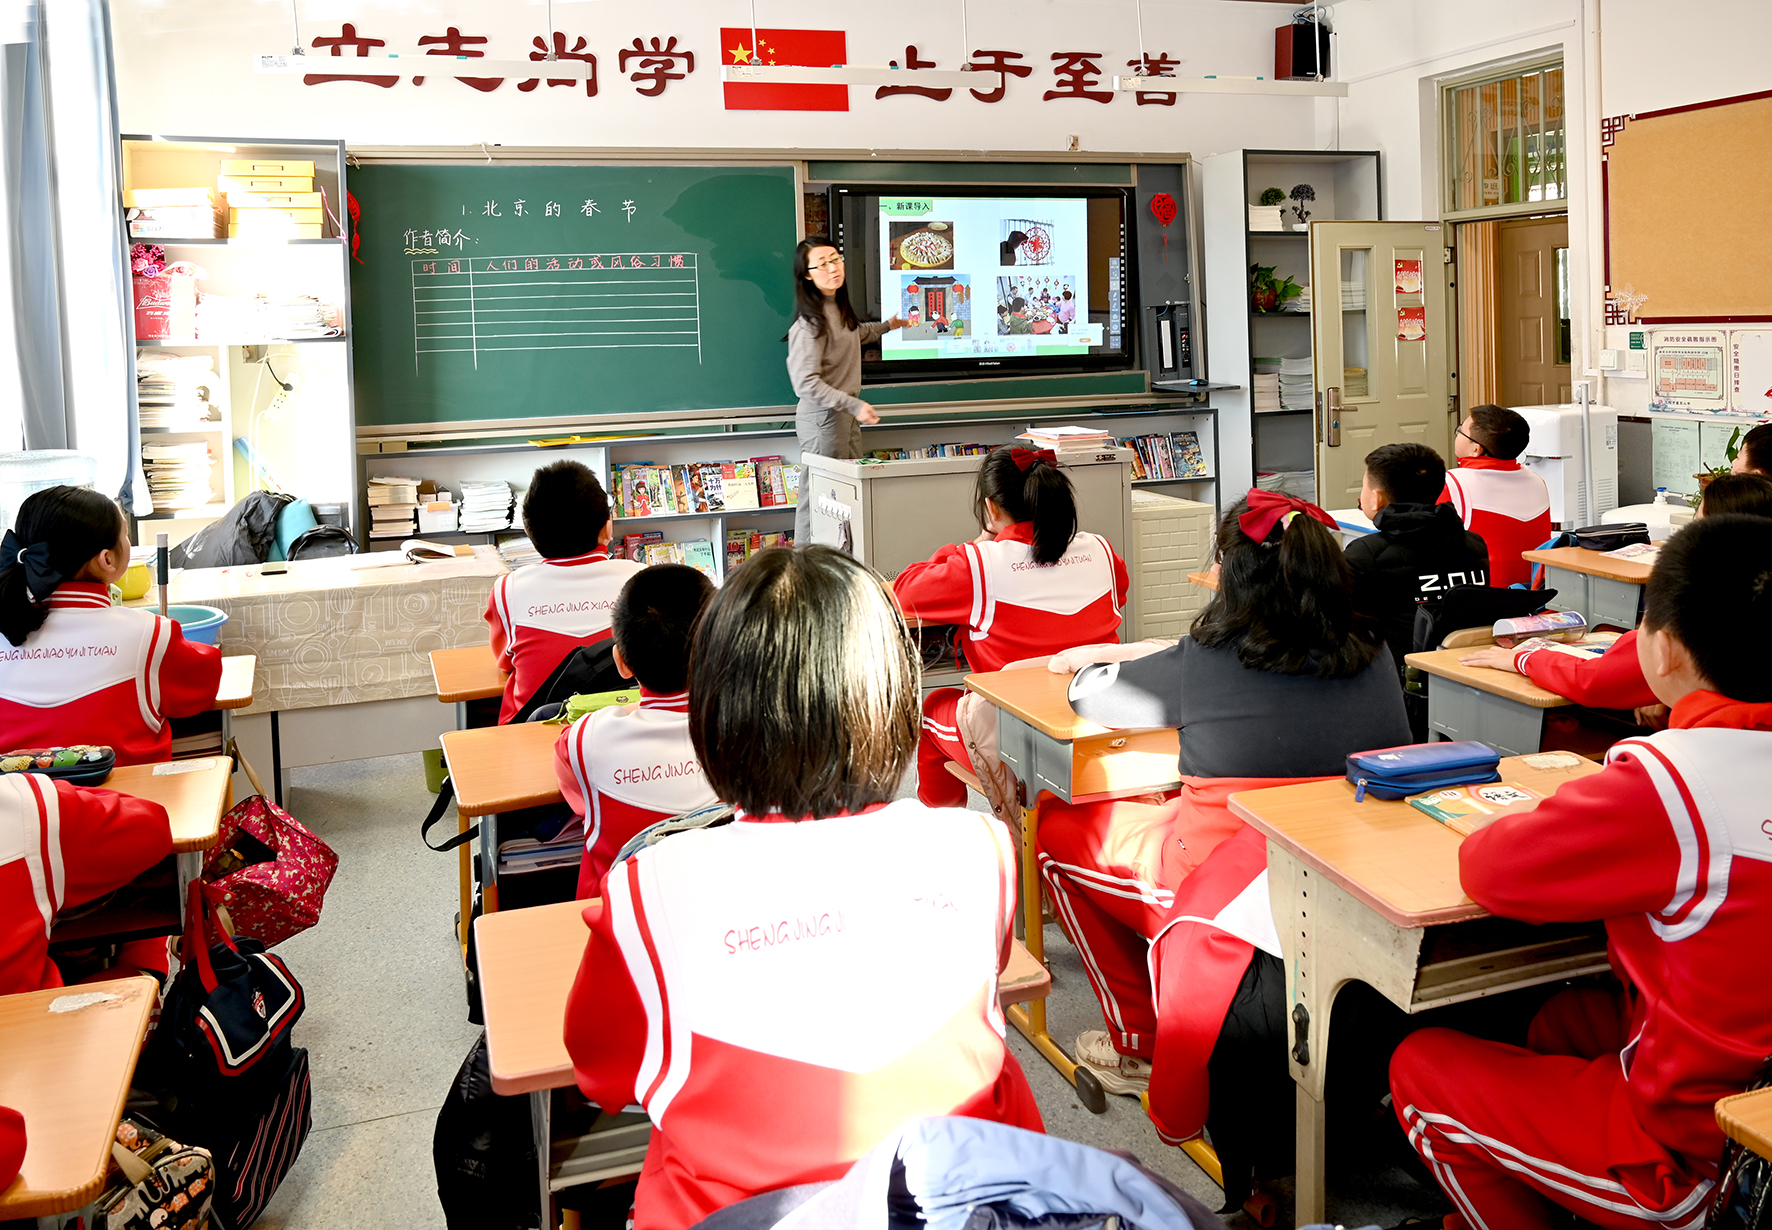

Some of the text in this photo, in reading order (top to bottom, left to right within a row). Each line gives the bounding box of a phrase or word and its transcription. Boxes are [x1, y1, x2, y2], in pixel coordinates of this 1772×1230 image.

[423, 259, 461, 274] 时间
[486, 254, 685, 271] 人们的活动或风俗习惯
[613, 765, 662, 785] SHENG
[664, 760, 695, 778] JING
[724, 920, 790, 955] SHENG
[794, 913, 832, 941] JING
